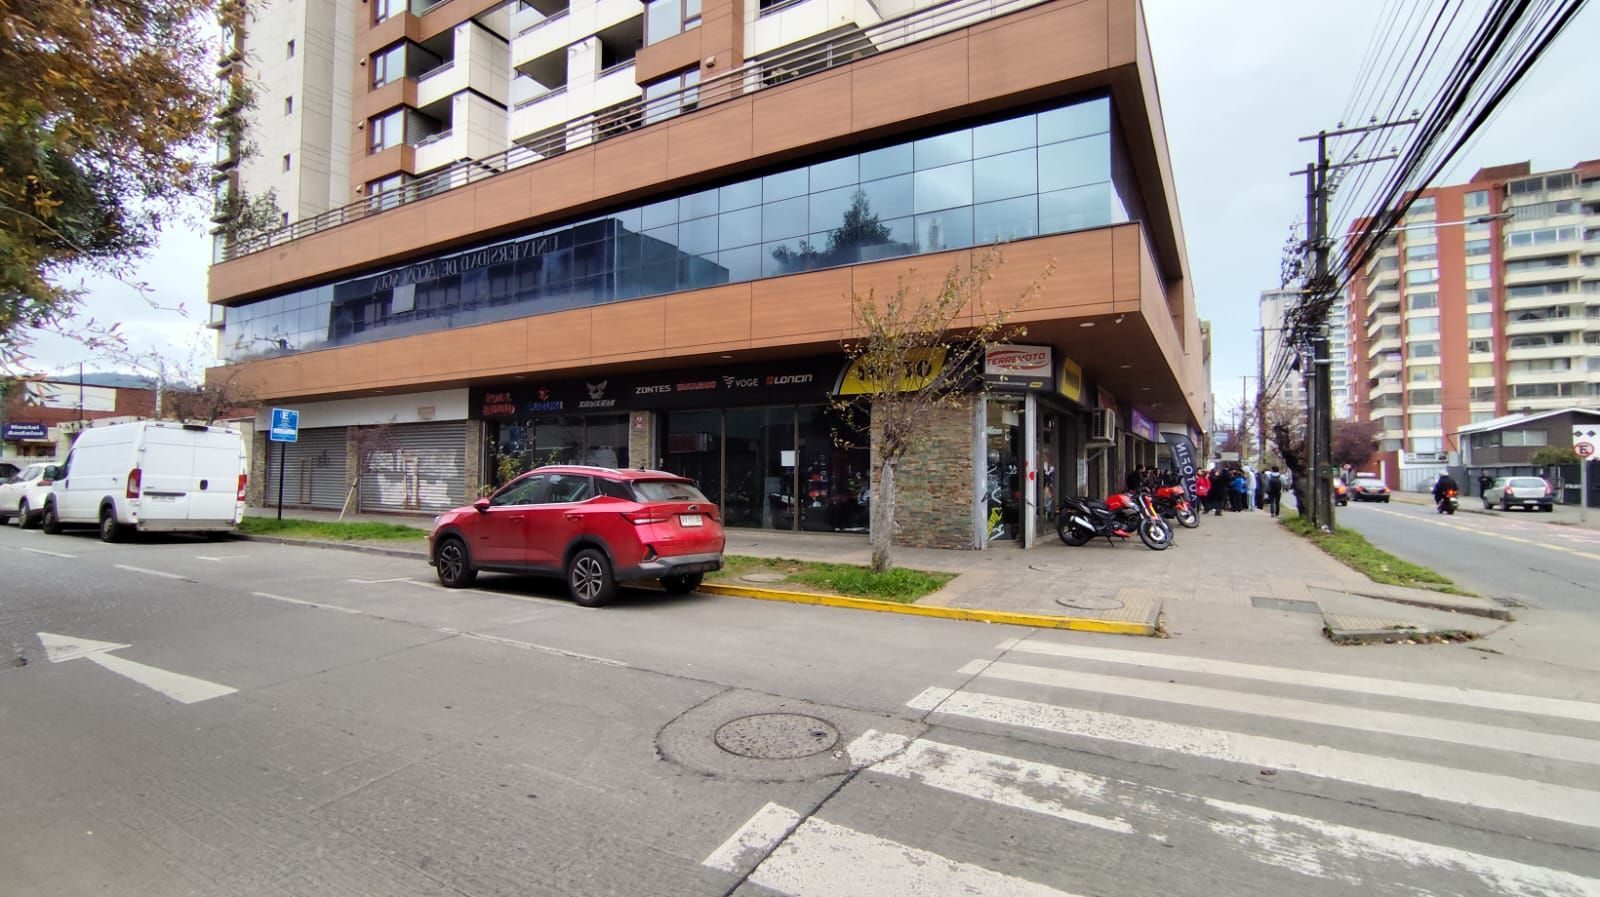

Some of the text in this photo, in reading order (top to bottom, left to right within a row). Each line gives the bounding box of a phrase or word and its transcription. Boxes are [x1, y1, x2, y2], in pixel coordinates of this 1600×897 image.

[735, 377, 759, 388] VOGE
[774, 373, 814, 385] LONCIN
[634, 384, 672, 395] ZONTES
